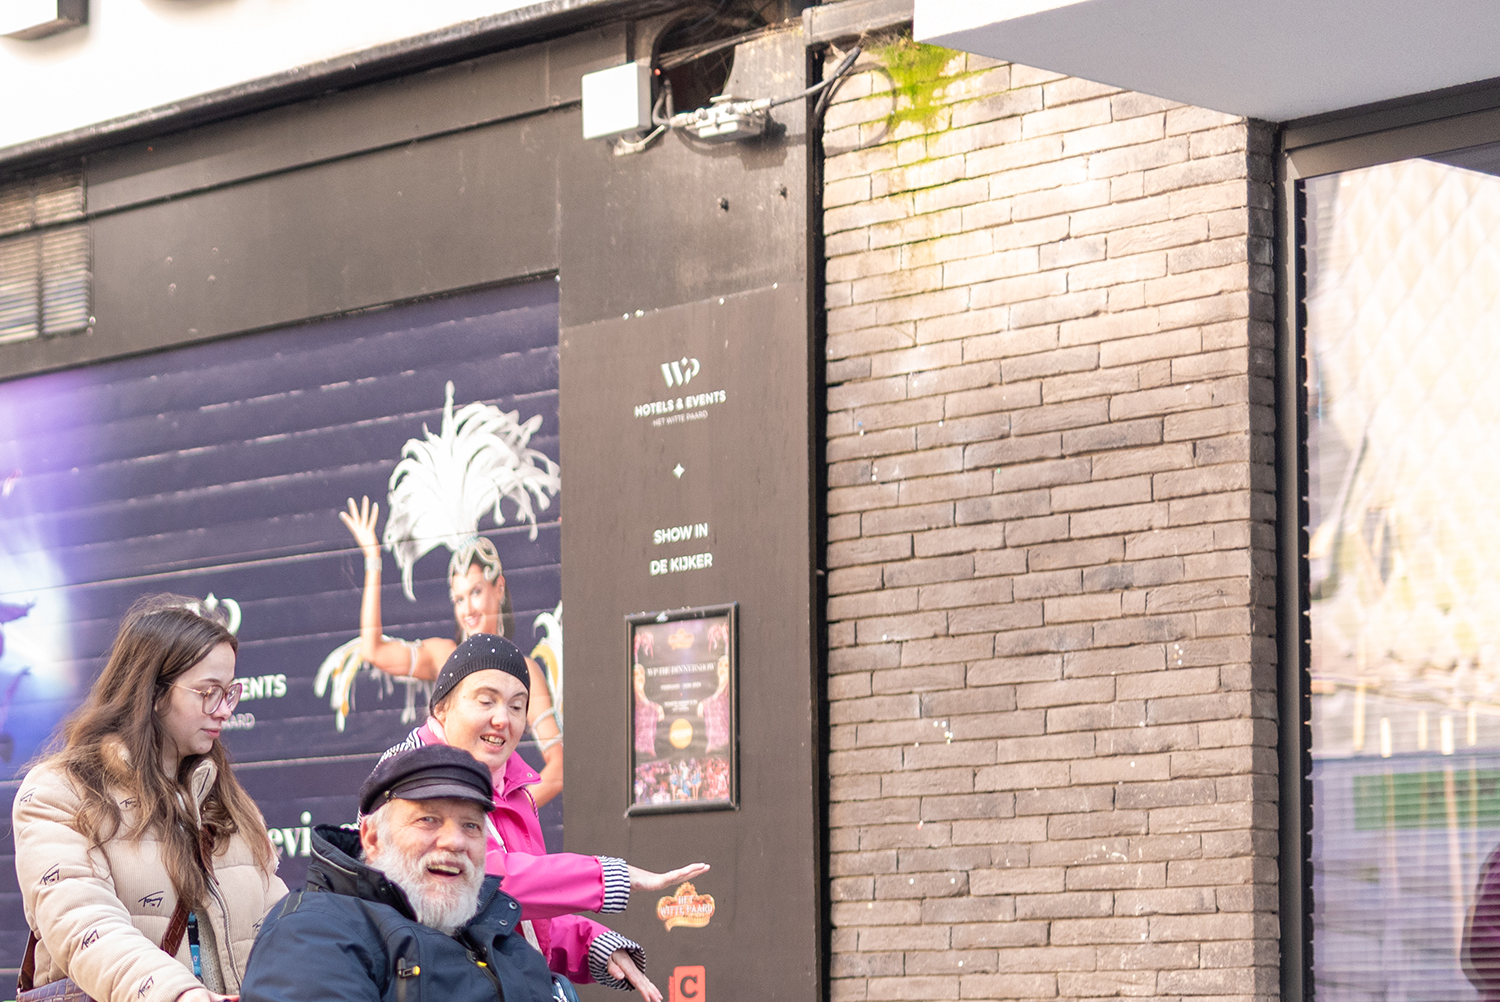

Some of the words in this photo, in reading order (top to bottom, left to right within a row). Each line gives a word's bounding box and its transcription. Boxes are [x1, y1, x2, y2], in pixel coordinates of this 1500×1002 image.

[634, 399, 675, 418] HOTELS
[676, 398, 684, 411] &
[685, 390, 727, 409] EVENTS
[666, 413, 685, 425] WITTE
[653, 525, 693, 545] SHOW
[694, 522, 708, 539] IN
[649, 559, 668, 576] DE
[670, 552, 713, 573] KIJKER
[660, 905, 685, 917] WITTE
[686, 903, 713, 915] PAARD
[677, 895, 694, 905] HET
[680, 975, 699, 999] C
